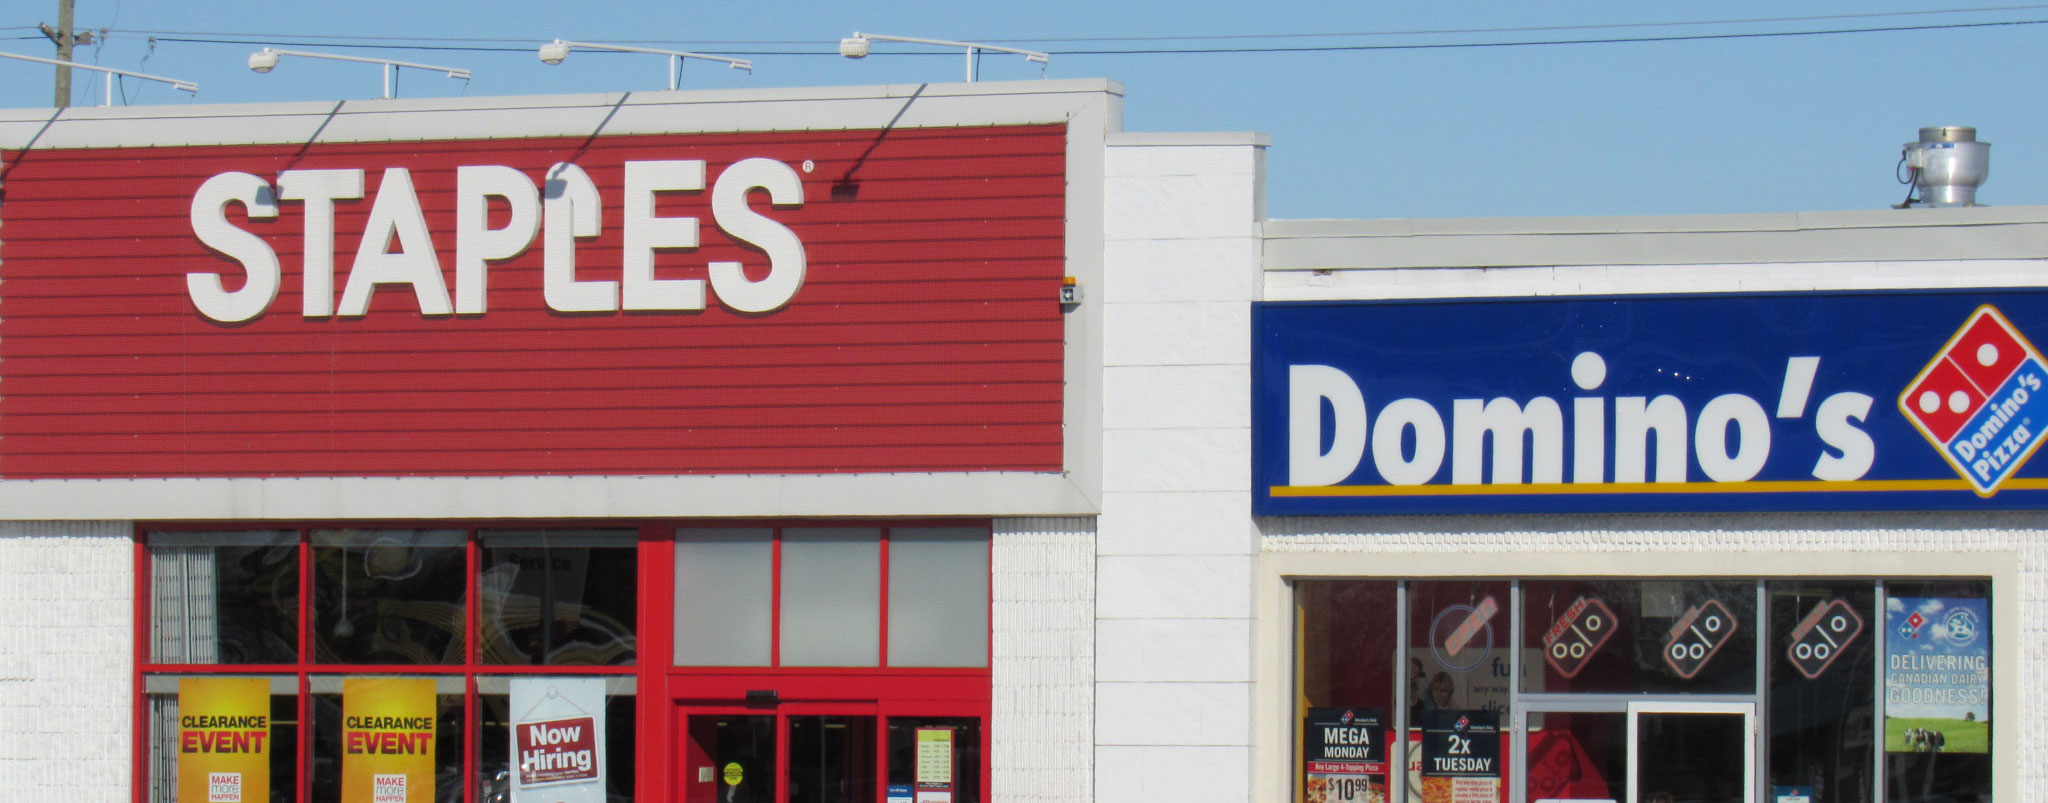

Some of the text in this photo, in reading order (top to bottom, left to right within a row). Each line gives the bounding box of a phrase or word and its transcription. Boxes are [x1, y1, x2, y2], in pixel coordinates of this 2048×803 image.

[187, 157, 806, 322] STAPLES
[1289, 351, 1875, 486] Domino's
[1954, 373, 2041, 463] Domino's
[1972, 424, 2032, 482] Pizza
[508, 552, 572, 571] Servce
[1546, 600, 1585, 646] FRESH
[1891, 654, 1985, 671] DELIVERING
[1891, 673, 1984, 685] CANADIAN DAIRY
[1890, 687, 1985, 704] GOODNESS!
[182, 716, 267, 728] CLEARANCE
[347, 716, 432, 729] CLEARANCE
[182, 731, 267, 753] EVENT
[347, 732, 432, 755] EVENT
[530, 724, 581, 746] Now
[1324, 727, 1369, 745] MEGA
[1324, 746, 1369, 758] MONDAY
[1447, 734, 1471, 754] 2x
[523, 747, 592, 771] Hiring
[1434, 757, 1491, 771] TUESDAY
[211, 776, 239, 785] MAKE
[211, 784, 239, 793] more
[376, 777, 404, 786] MAKE
[211, 793, 239, 801] HAPPEN
[376, 786, 404, 795] more
